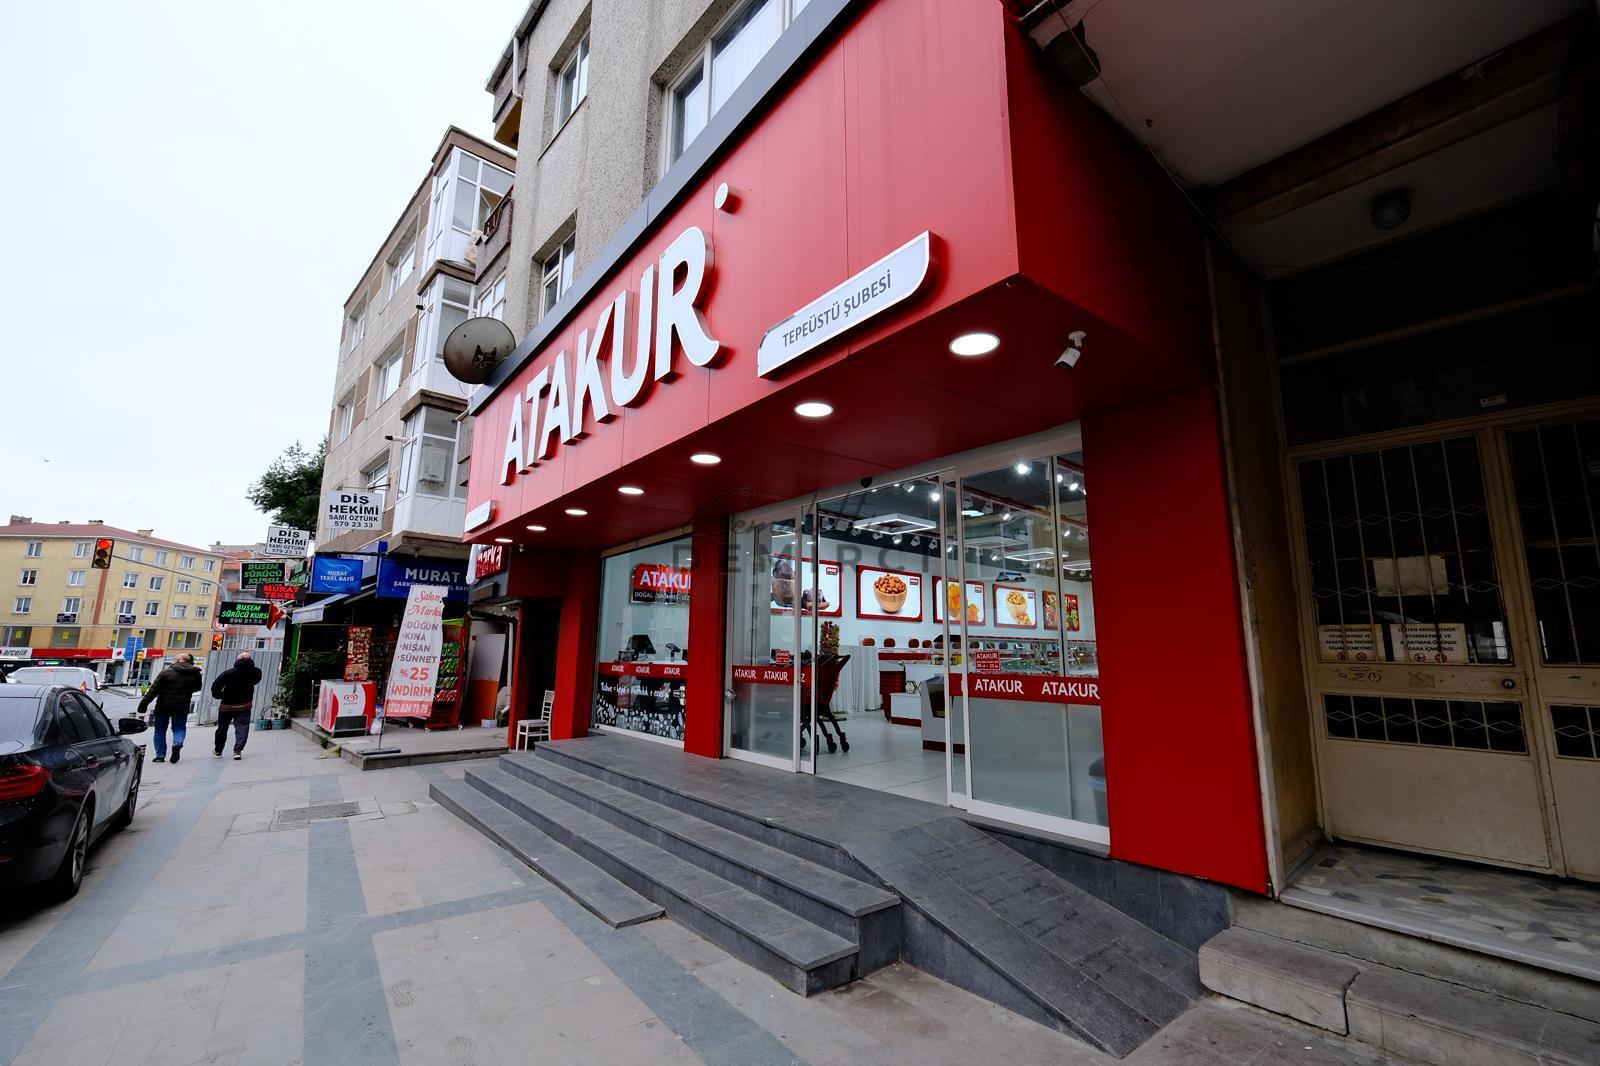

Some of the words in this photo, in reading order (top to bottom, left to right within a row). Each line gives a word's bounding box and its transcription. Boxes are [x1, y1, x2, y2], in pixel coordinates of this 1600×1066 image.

[782, 302, 840, 347] TEPEÜSTÜ
[844, 269, 891, 317] ŞUBESİ
[500, 226, 720, 486] ATAKUR
[341, 494, 370, 505] DİŞ
[330, 505, 379, 515] HEKİMİ
[270, 537, 307, 546] HEKİMİ
[405, 568, 461, 583] MURAT
[407, 621, 438, 630] DÜĞÜN
[404, 632, 426, 641] KINA
[402, 643, 431, 652] NİŞAN
[400, 654, 437, 663] SÜNNET
[734, 669, 757, 680] ATAKUR
[764, 671, 789, 682] ATAKUR
[391, 683, 432, 697] İNDİRİM
[975, 678, 1024, 695] ATAKUR
[1042, 681, 1101, 700] ATAKUR
